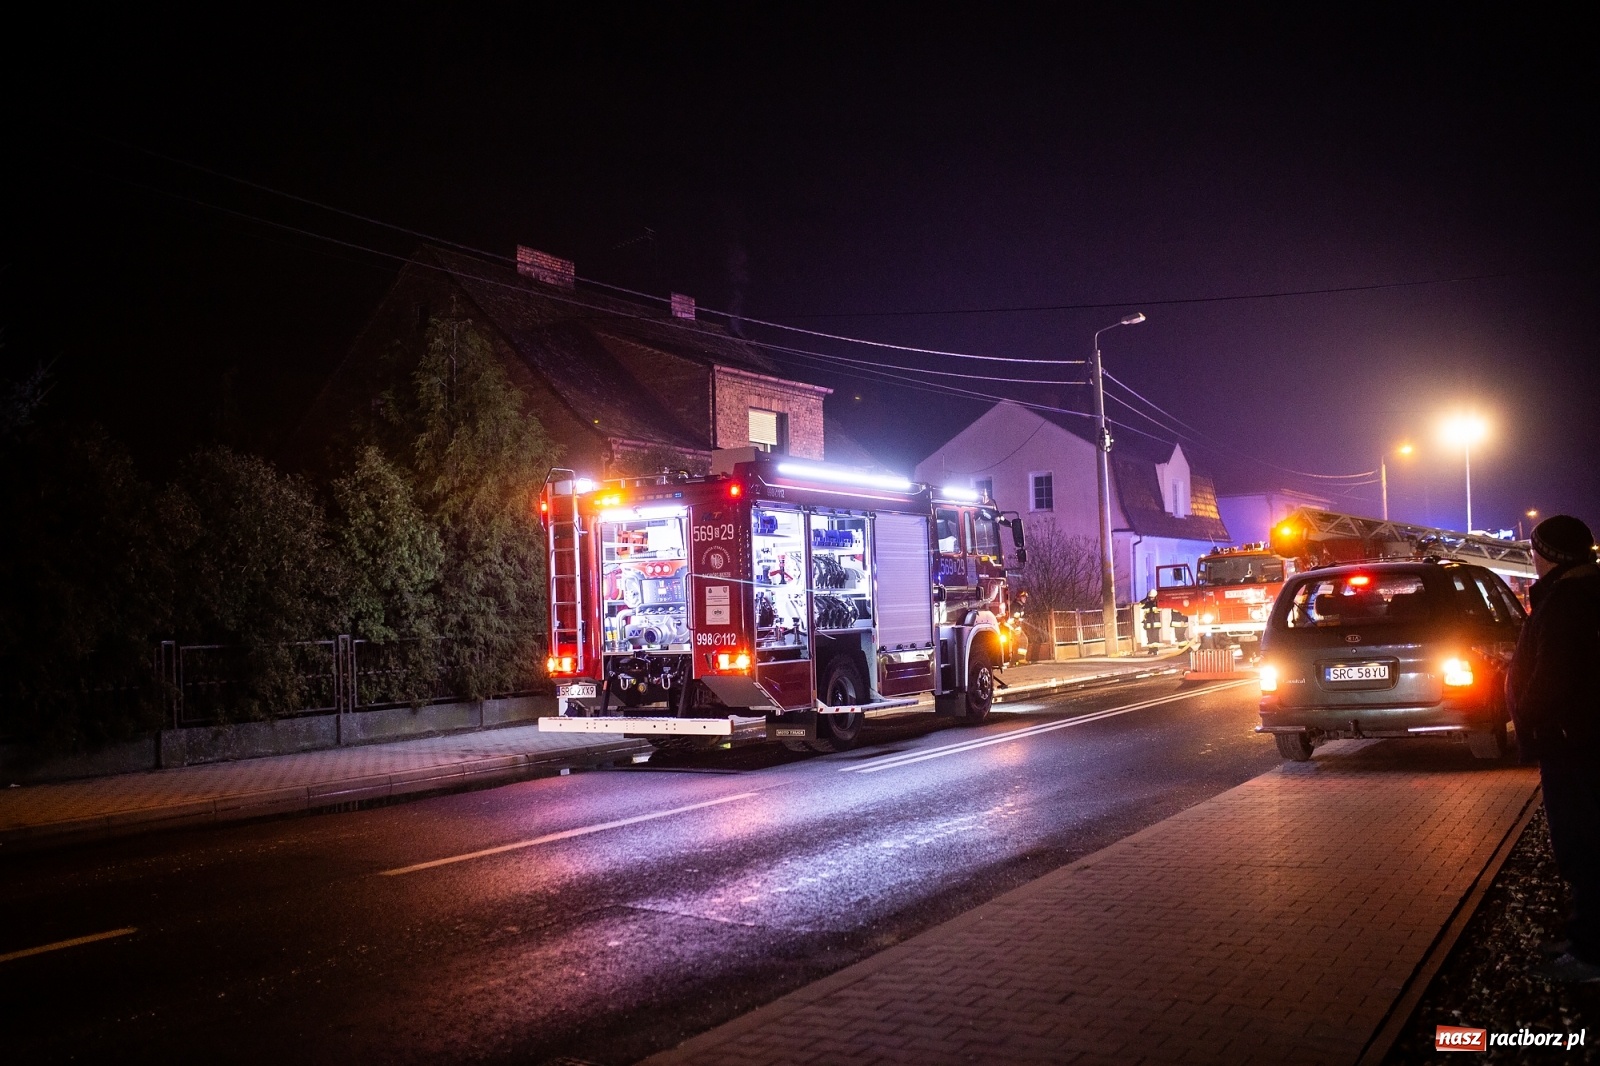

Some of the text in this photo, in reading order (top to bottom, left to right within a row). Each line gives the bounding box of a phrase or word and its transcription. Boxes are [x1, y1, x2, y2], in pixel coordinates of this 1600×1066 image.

[693, 525, 714, 541] 569
[720, 523, 734, 541] 29
[696, 632, 737, 646] 998 112
[1332, 668, 1354, 680] SRC
[1357, 667, 1386, 679] 58YU
